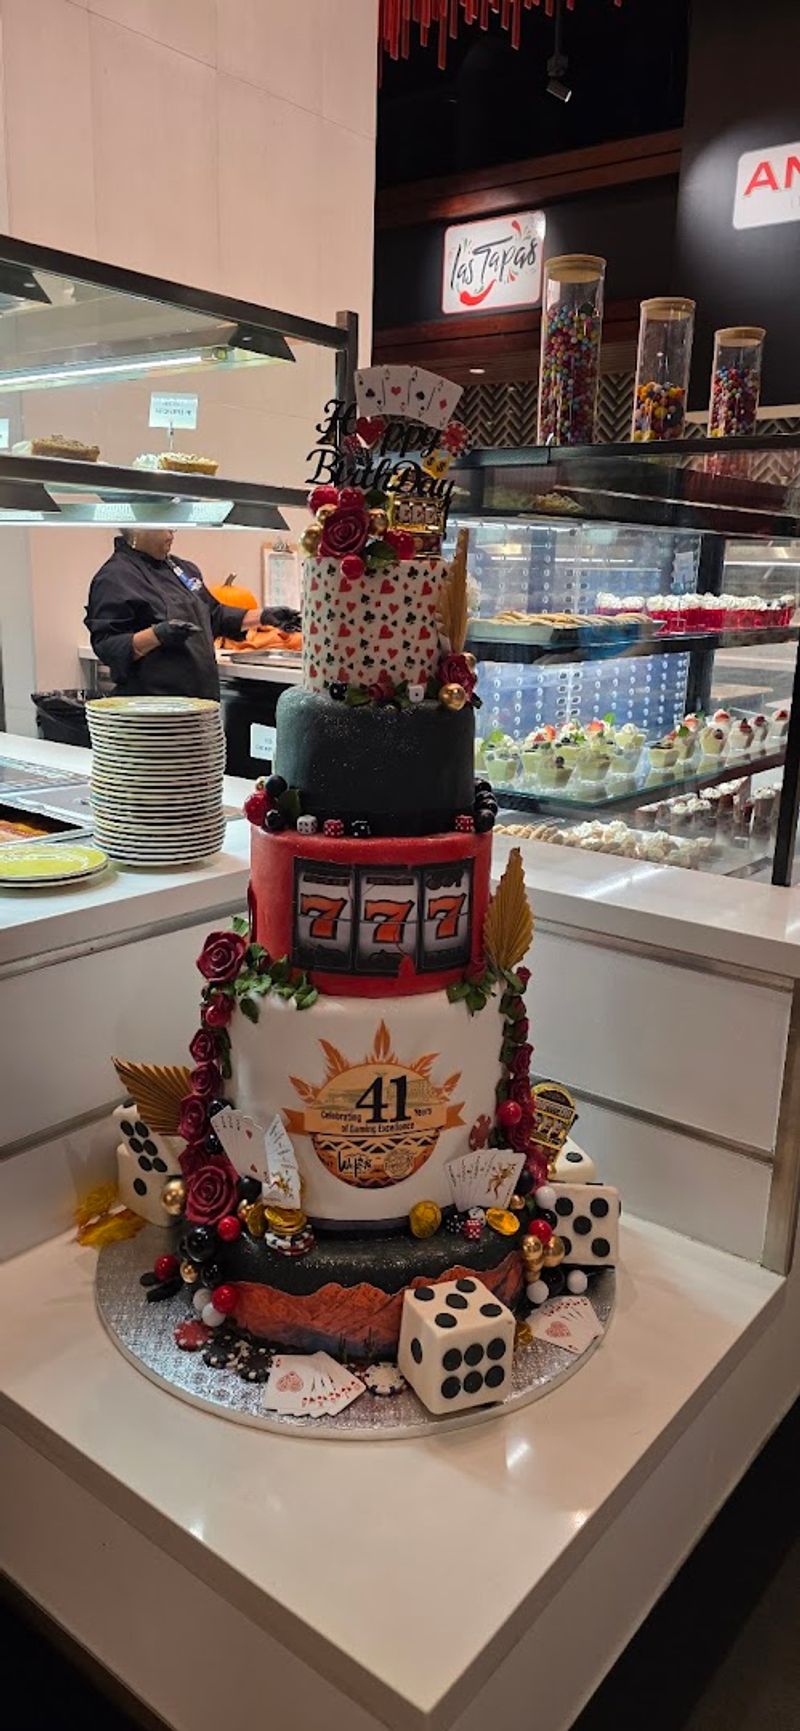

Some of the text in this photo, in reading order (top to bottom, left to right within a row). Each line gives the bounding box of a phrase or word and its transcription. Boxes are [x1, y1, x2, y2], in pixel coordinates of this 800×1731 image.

[472, 235, 538, 283] Tapas
[315, 399, 441, 459] Hppy
[300, 892, 468, 944] 7 7 7
[320, 1110, 362, 1123] Celebrating
[355, 1074, 411, 1124] 41
[349, 1125, 377, 1134] Gaming
[378, 1122, 415, 1133] Excellence
